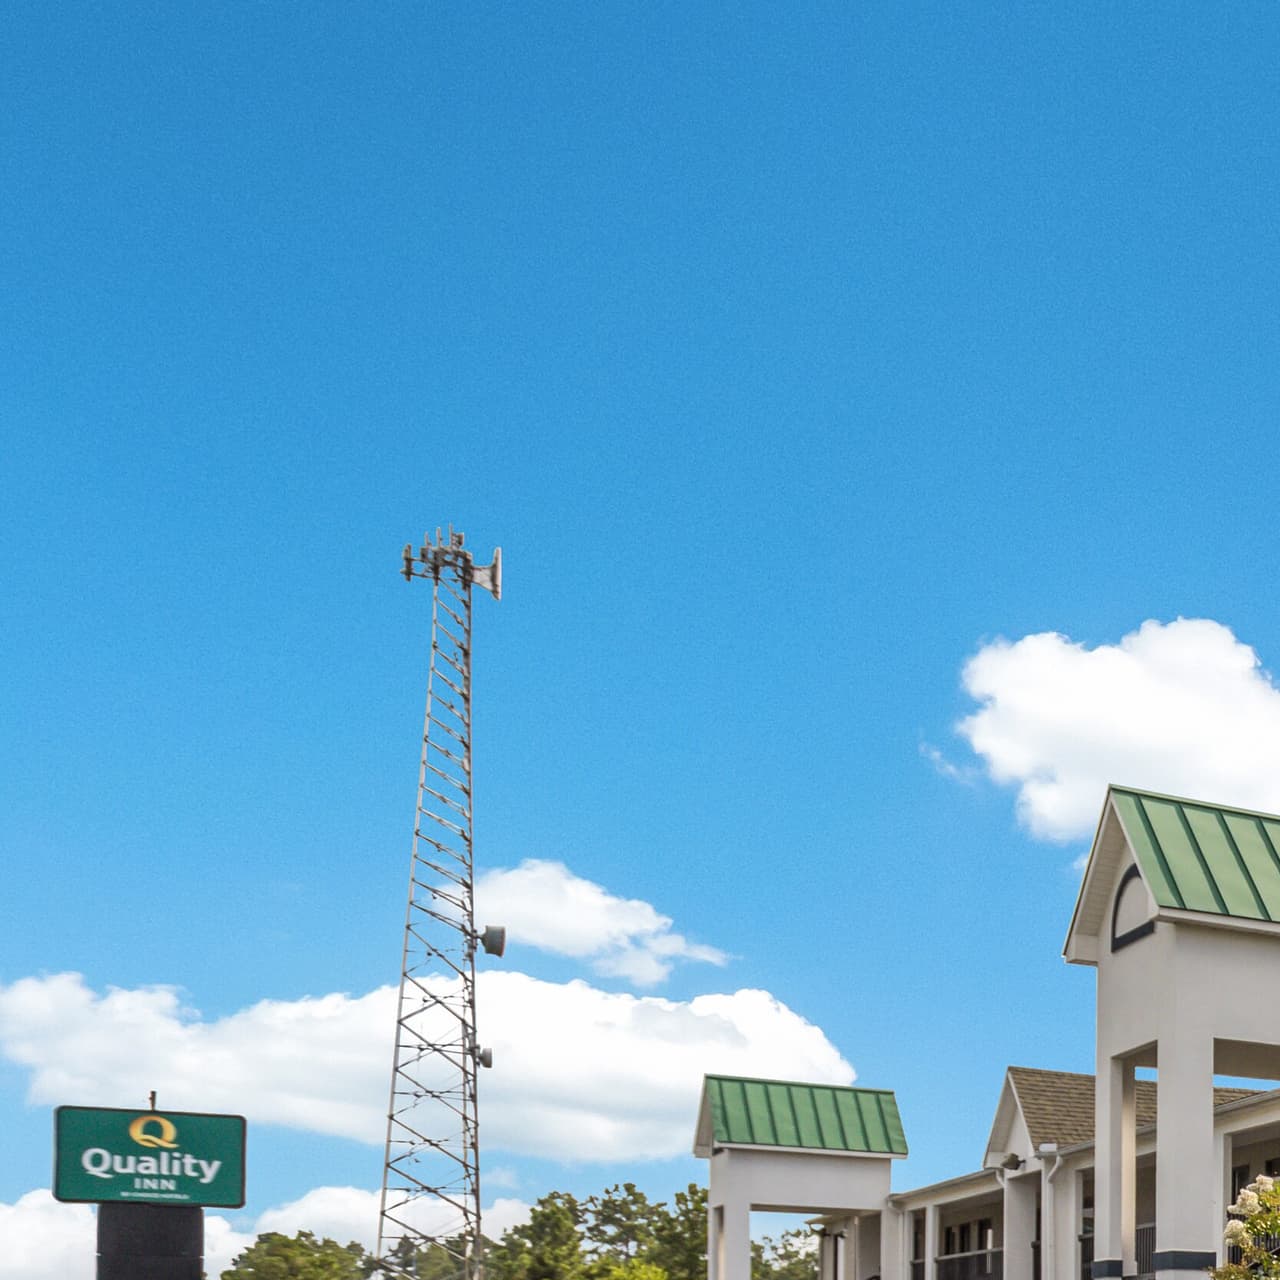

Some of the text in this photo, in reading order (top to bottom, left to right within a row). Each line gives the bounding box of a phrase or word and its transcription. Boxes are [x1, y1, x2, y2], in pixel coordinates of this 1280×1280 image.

[129, 1115, 179, 1148] Q
[81, 1148, 222, 1184] Quality
[134, 1177, 176, 1191] INN
